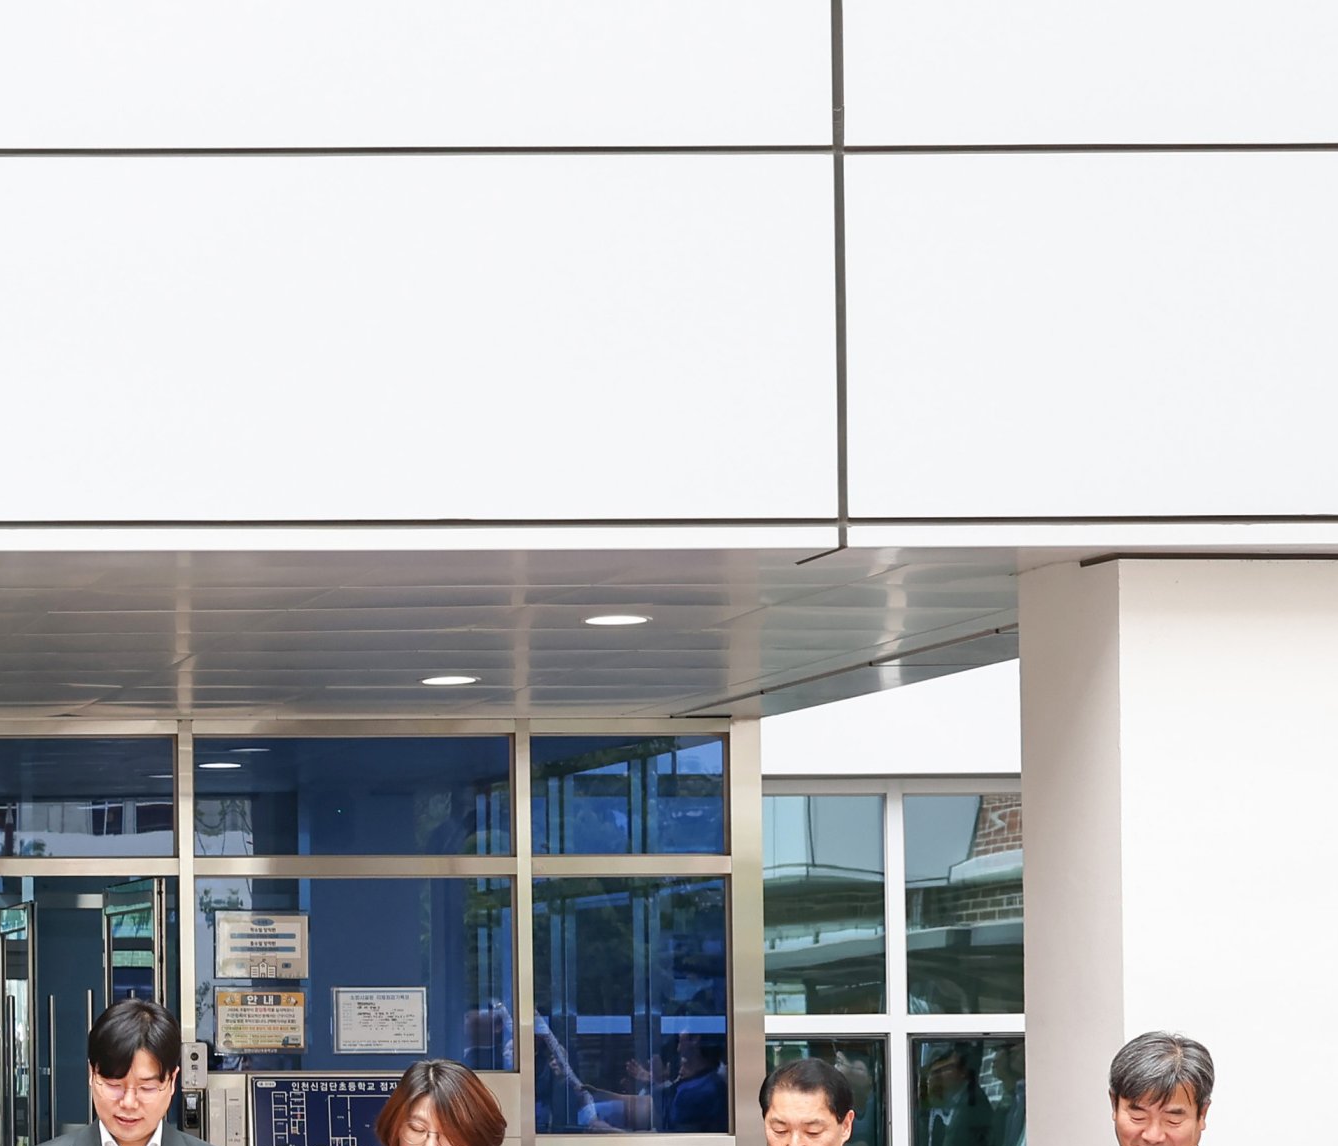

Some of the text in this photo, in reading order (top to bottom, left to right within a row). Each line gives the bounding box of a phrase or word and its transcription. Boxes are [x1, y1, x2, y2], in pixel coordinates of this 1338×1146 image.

[247, 995, 274, 1005] 안 내
[291, 1081, 375, 1091] 인천신검단초등학교
